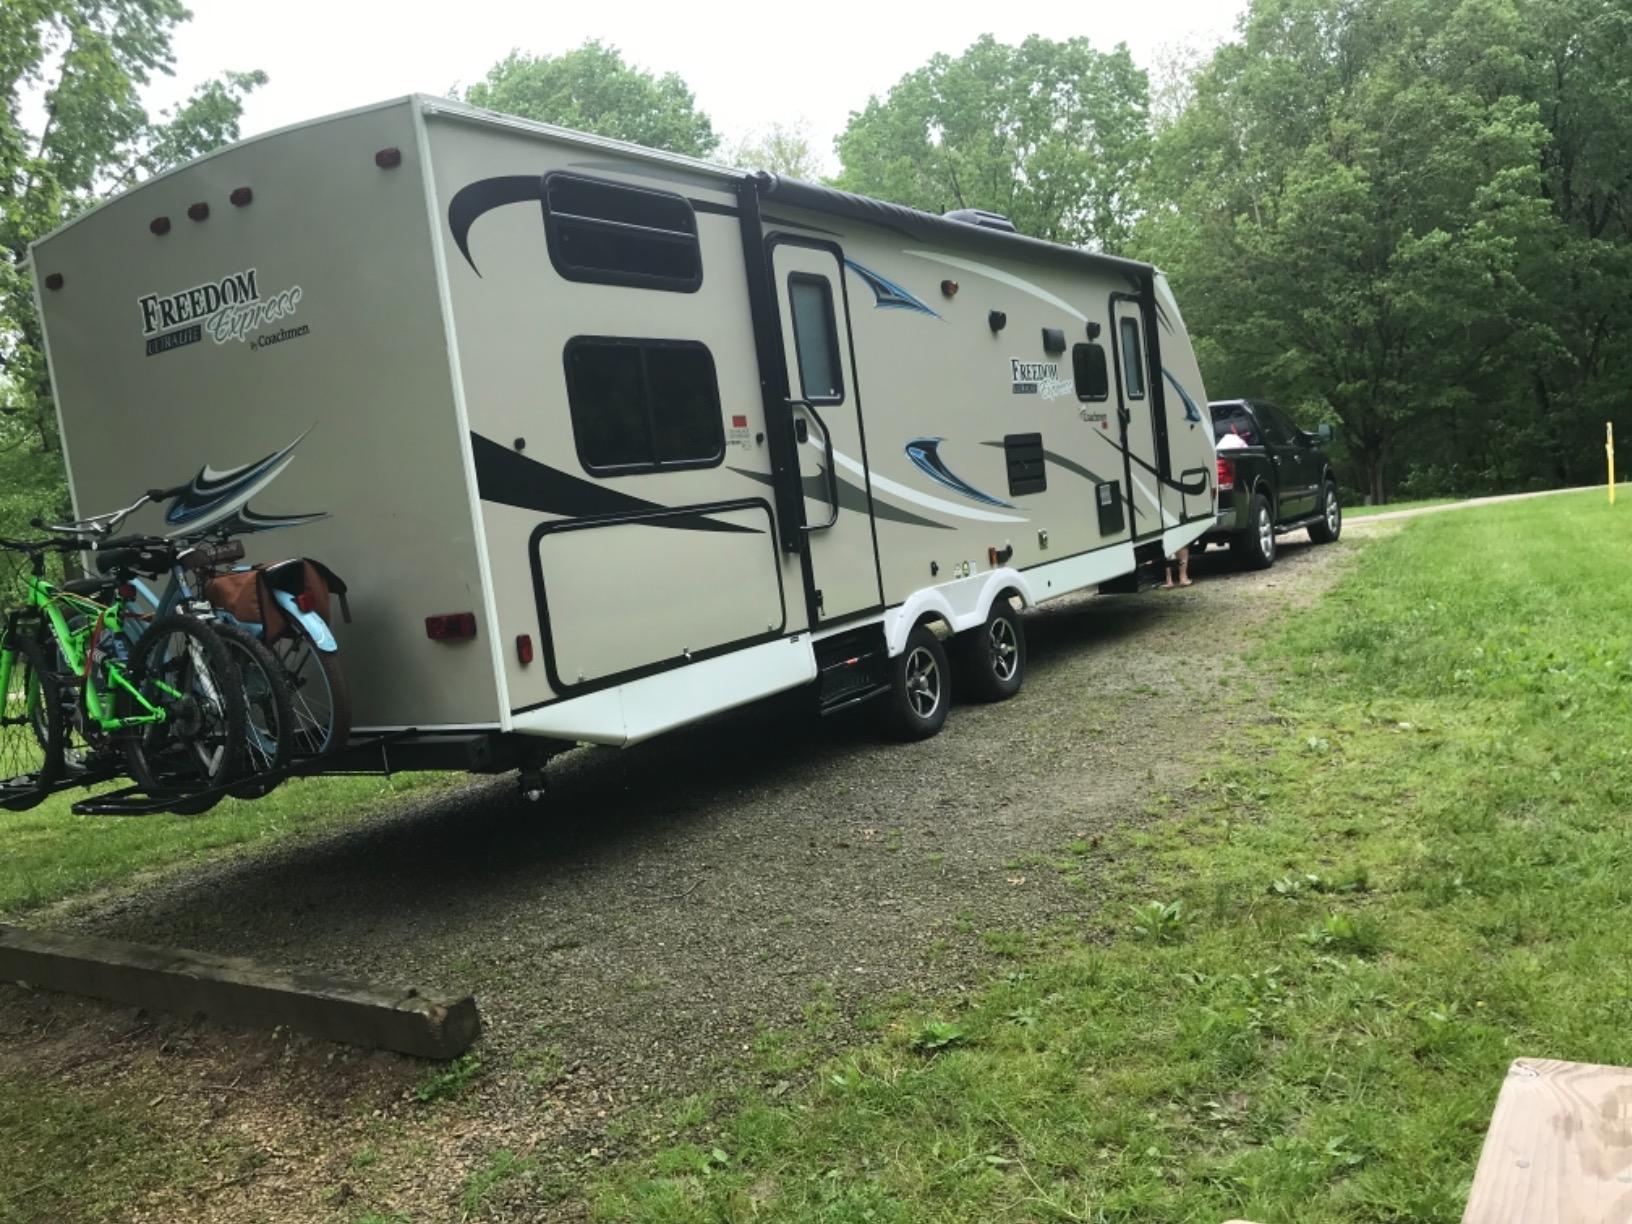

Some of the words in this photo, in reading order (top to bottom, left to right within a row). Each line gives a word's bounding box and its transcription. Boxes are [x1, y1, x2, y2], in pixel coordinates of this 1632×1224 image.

[139, 269, 259, 334] FREEDOM
[207, 287, 301, 343] Express
[257, 324, 310, 348] Coachmen
